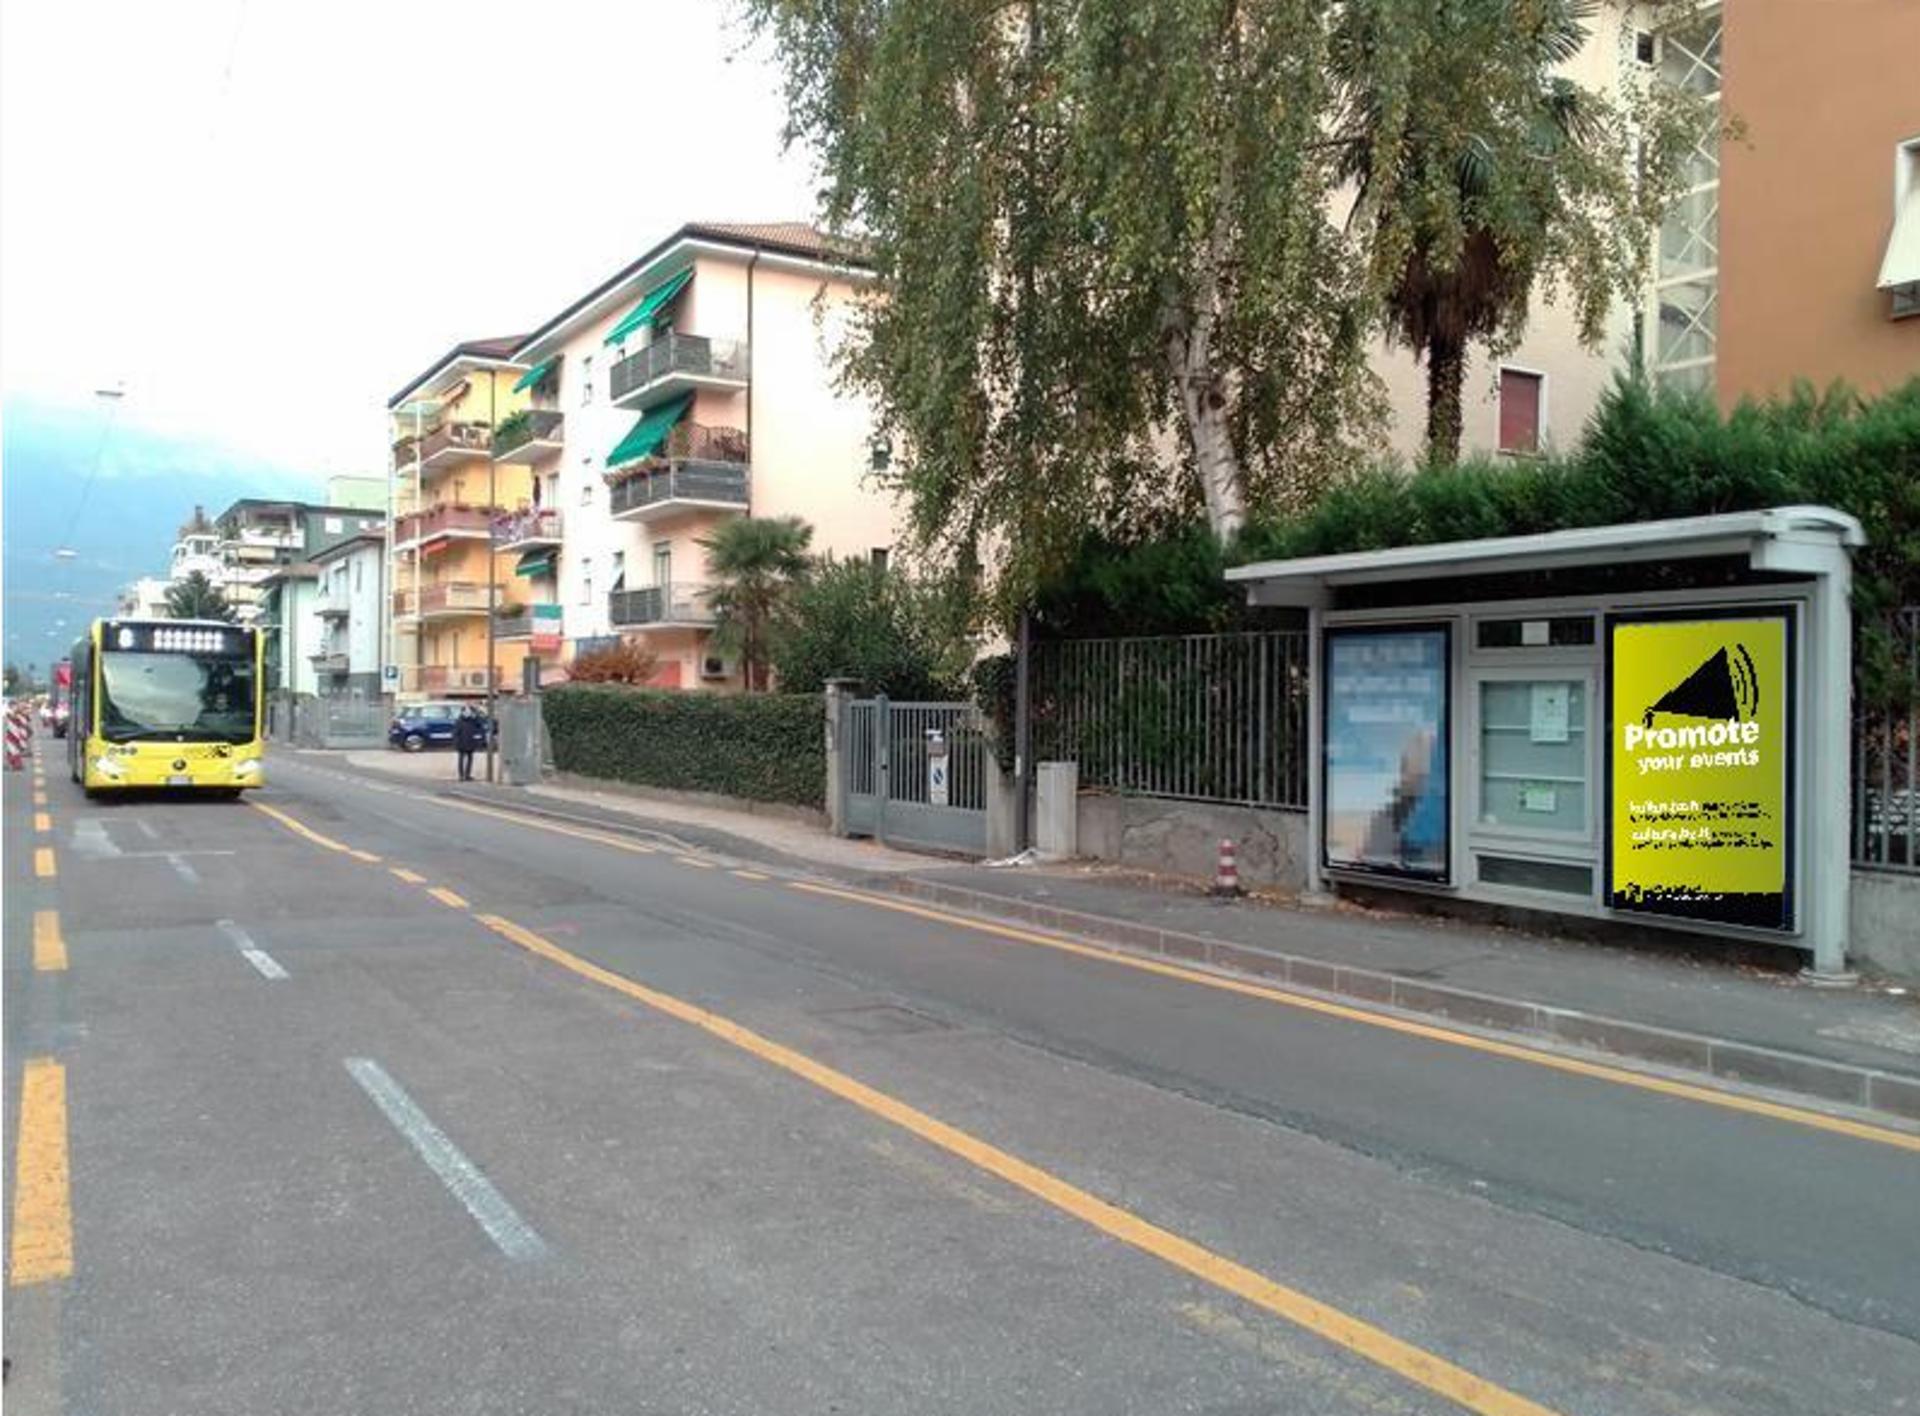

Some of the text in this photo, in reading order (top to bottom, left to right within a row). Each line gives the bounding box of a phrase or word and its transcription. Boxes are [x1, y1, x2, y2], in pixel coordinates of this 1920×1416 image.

[1623, 718, 1760, 751] Promote
[1638, 748, 1760, 775] your events
